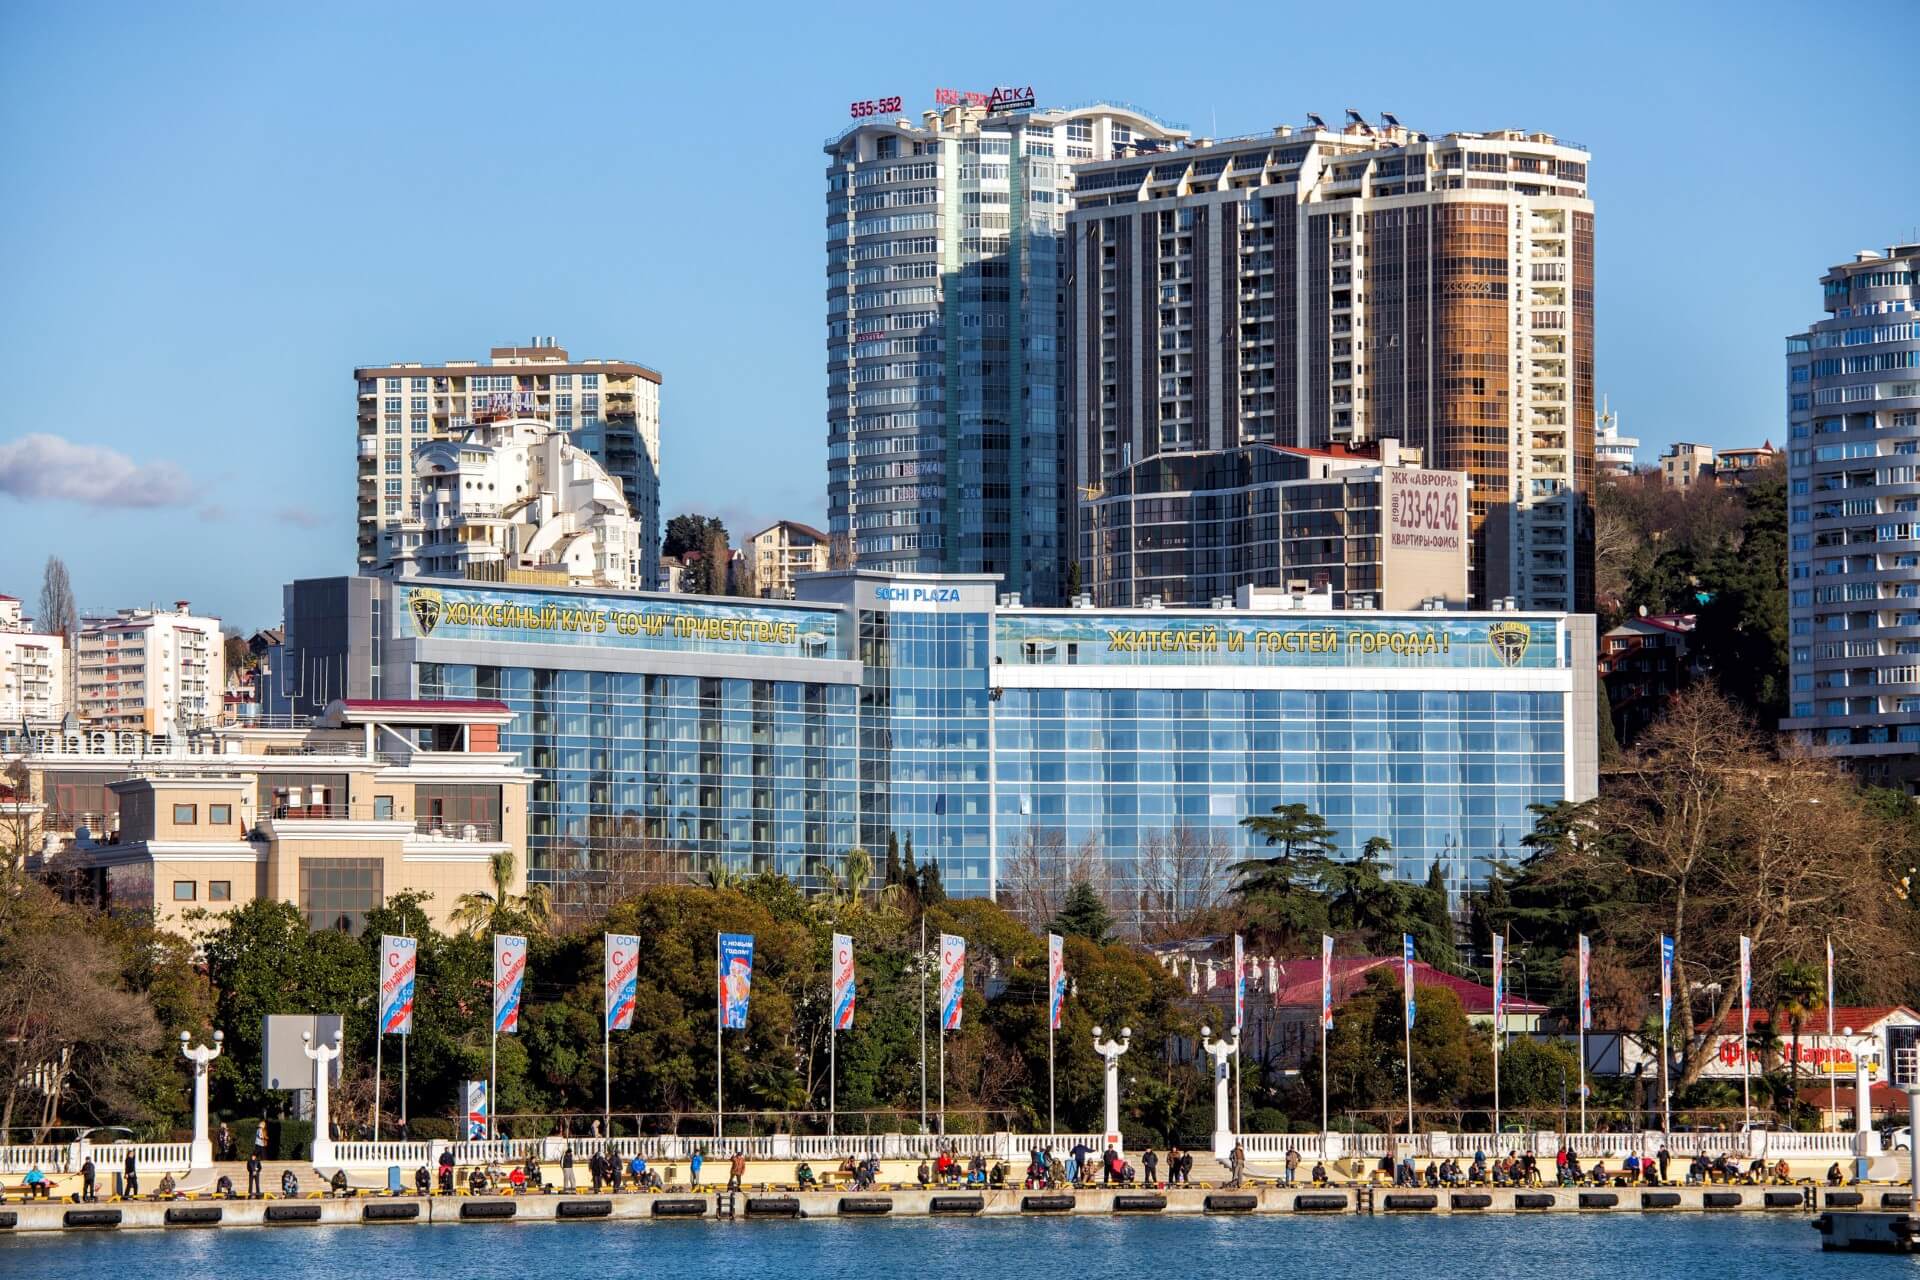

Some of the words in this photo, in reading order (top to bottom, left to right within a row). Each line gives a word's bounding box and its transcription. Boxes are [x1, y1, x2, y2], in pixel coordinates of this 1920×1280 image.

[851, 96, 901, 118] 555-552
[1392, 472, 1408, 485] ЖК
[1410, 473, 1458, 487] «АВРОРА»
[1400, 489, 1459, 530] 233-62-62
[875, 587, 909, 601] SOCHI
[913, 588, 960, 602] PLAZA
[446, 600, 558, 630] ХОККЕЙНЫЙ
[561, 608, 607, 633] КЛУБ
[609, 611, 669, 637] "СОЧИ"
[674, 616, 798, 644] ПРИВЕТСТВУЕТ
[1107, 625, 1217, 652] ЖИТЕЛЕЙ
[1227, 631, 1245, 652] И
[1255, 627, 1338, 653] ГОСТЕЙ
[392, 938, 416, 949] СОЧ
[505, 937, 527, 947] СОЧ
[616, 936, 639, 946] СОЧ
